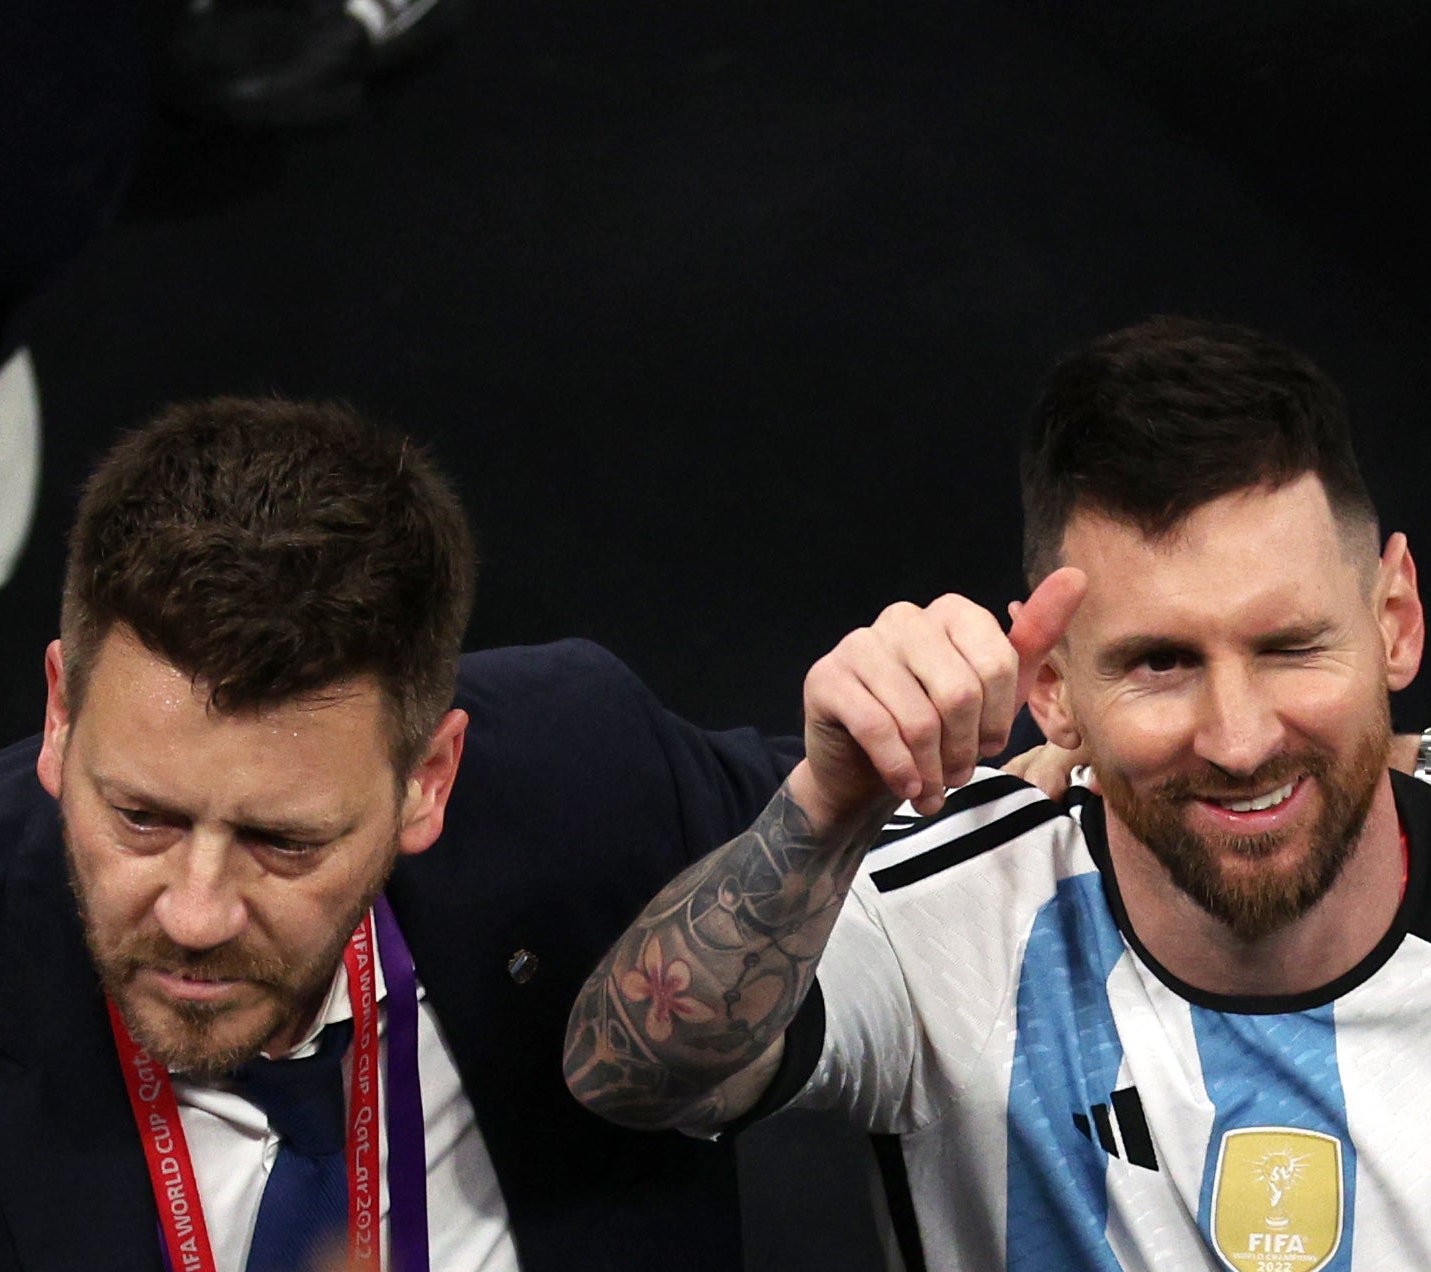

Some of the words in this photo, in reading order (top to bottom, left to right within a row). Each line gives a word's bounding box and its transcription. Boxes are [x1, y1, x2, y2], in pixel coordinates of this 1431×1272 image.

[358, 1052, 370, 1094] CUP
[149, 1112, 174, 1154] CUP
[161, 1156, 194, 1239] WORLD
[1248, 1232, 1306, 1254] FIFA
[1256, 1261, 1292, 1272] 2022
